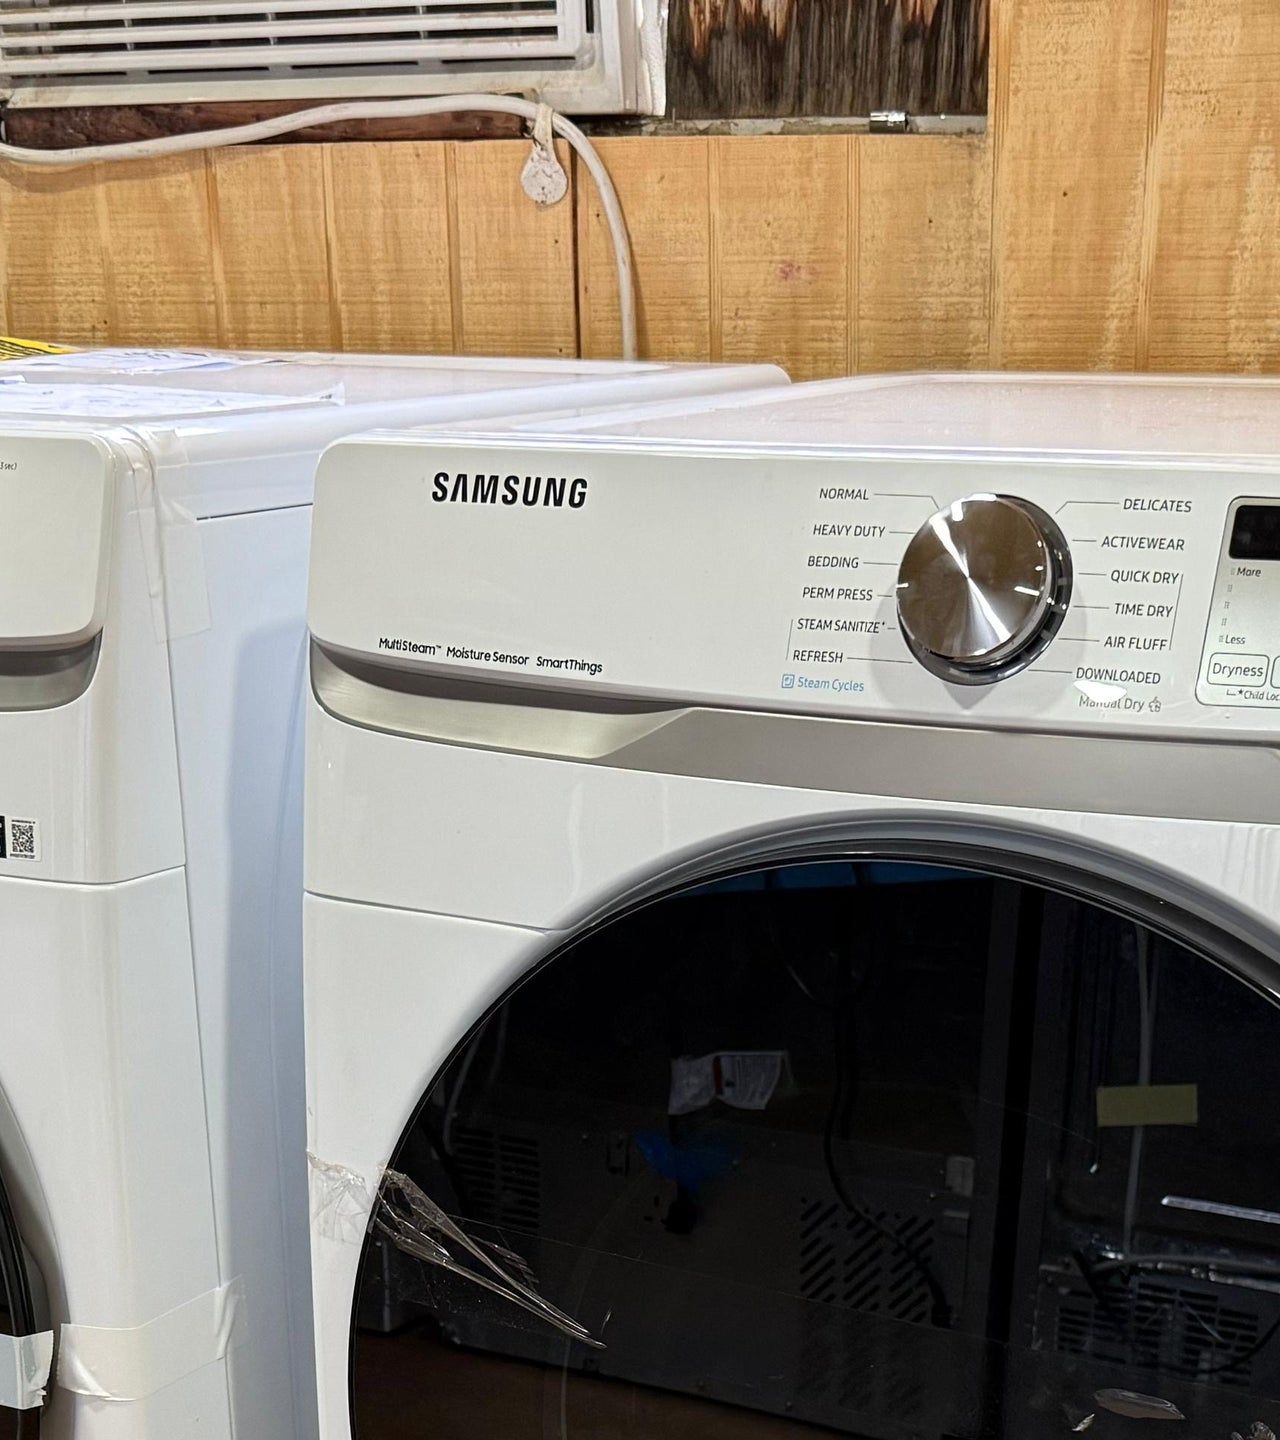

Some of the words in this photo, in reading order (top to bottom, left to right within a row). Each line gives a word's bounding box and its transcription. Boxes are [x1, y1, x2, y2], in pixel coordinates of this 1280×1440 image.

[432, 471, 588, 509] SAMSUNG
[819, 487, 869, 501] NORMAL
[1123, 498, 1193, 513] DELICATES
[812, 524, 852, 536] HEAVY
[853, 525, 886, 538] DUTY
[1101, 535, 1185, 551] ACTIVEWEAR
[807, 555, 859, 569] BEDDING
[1110, 569, 1150, 583] QUICK
[1152, 571, 1180, 585] DRY
[1236, 566, 1262, 578] More
[802, 586, 835, 599] PERM
[837, 588, 873, 601] PRESS
[1114, 602, 1145, 616] TIME
[1146, 604, 1174, 618] DRY
[797, 618, 833, 631] STEAM
[1103, 635, 1127, 649] AIR
[1128, 637, 1168, 651] FLUFF
[1224, 634, 1246, 645] Less
[446, 646, 491, 663] Moisture
[493, 651, 530, 666] Sensor
[536, 656, 603, 676] SmartThings
[792, 649, 844, 663] REFRESH
[1076, 667, 1161, 685] DOWNLOADED
[1212, 662, 1264, 678] Dryness
[797, 676, 830, 690] Steam
[831, 678, 865, 693] Cycles
[1124, 697, 1145, 713] Dry
